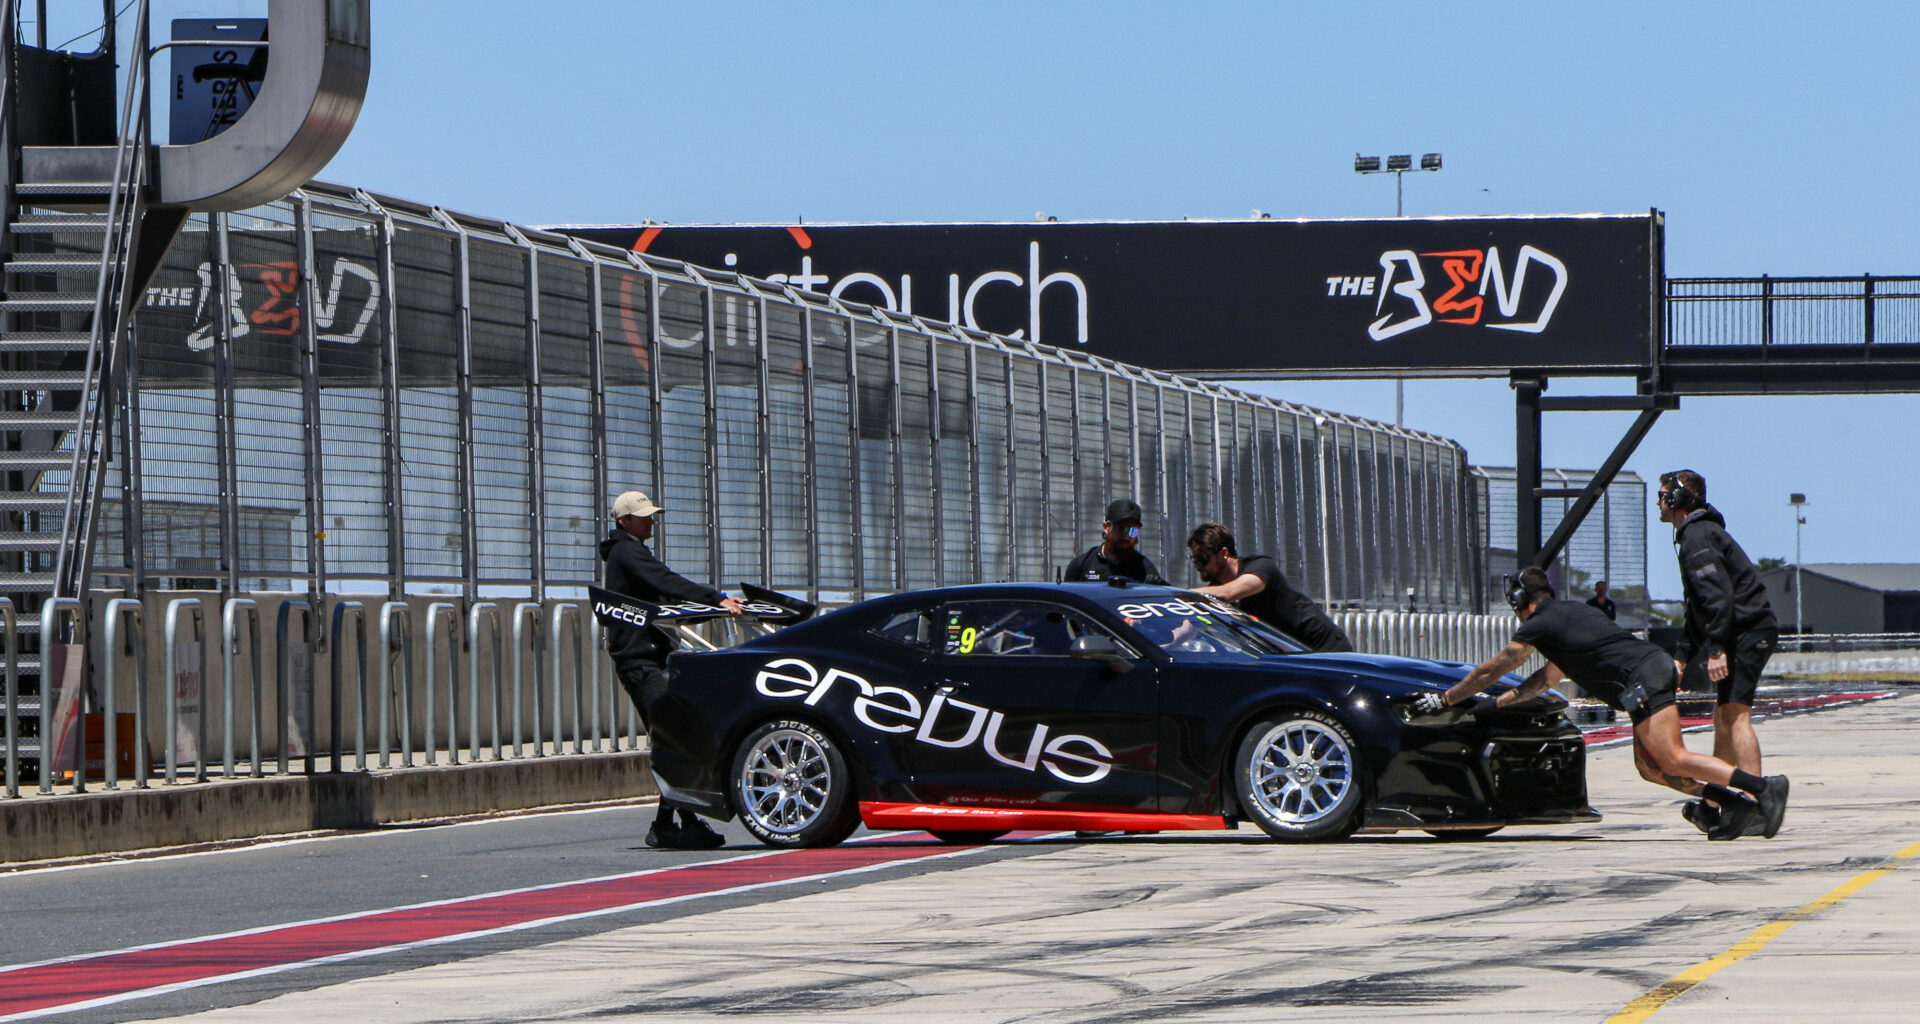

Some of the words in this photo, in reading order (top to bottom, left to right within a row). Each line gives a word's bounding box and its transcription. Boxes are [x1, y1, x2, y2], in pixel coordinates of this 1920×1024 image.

[212, 50, 238, 124] KERS
[146, 287, 195, 307] THE
[1326, 276, 1376, 297] THE
[1368, 245, 1568, 341] BEND
[959, 627, 977, 654] 9
[755, 658, 1114, 784] erebus
[779, 720, 830, 750] DUNLOP
[1303, 708, 1356, 748] DUNLOP
